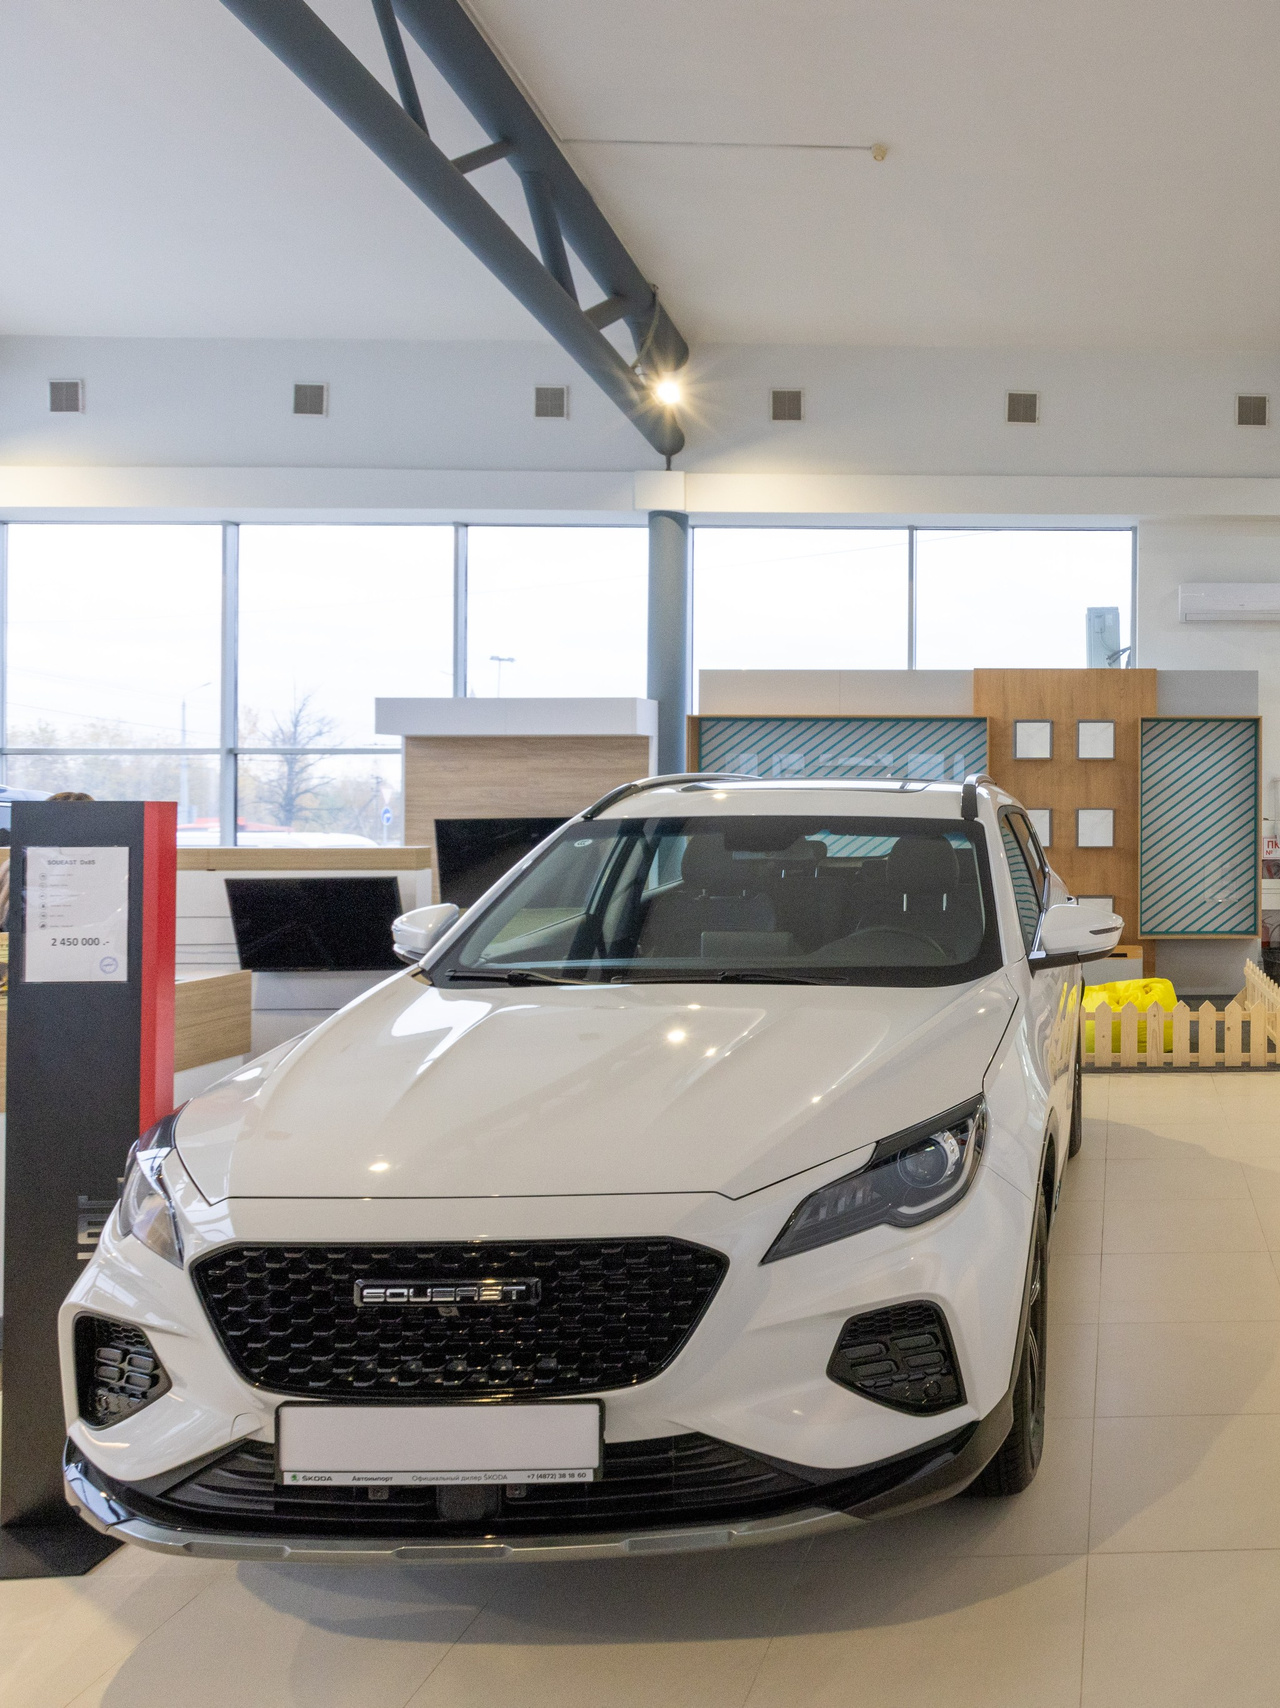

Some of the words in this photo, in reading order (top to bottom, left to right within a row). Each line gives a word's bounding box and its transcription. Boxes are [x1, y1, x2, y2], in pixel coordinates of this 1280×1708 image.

[51, 938, 57, 947] 2
[59, 938, 79, 946] 450
[81, 938, 100, 946] 000
[362, 1285, 526, 1302] SOUEAST
[352, 1475, 393, 1483] Автоимпорт
[412, 1474, 460, 1482] Официальный
[460, 1474, 482, 1482] дилер
